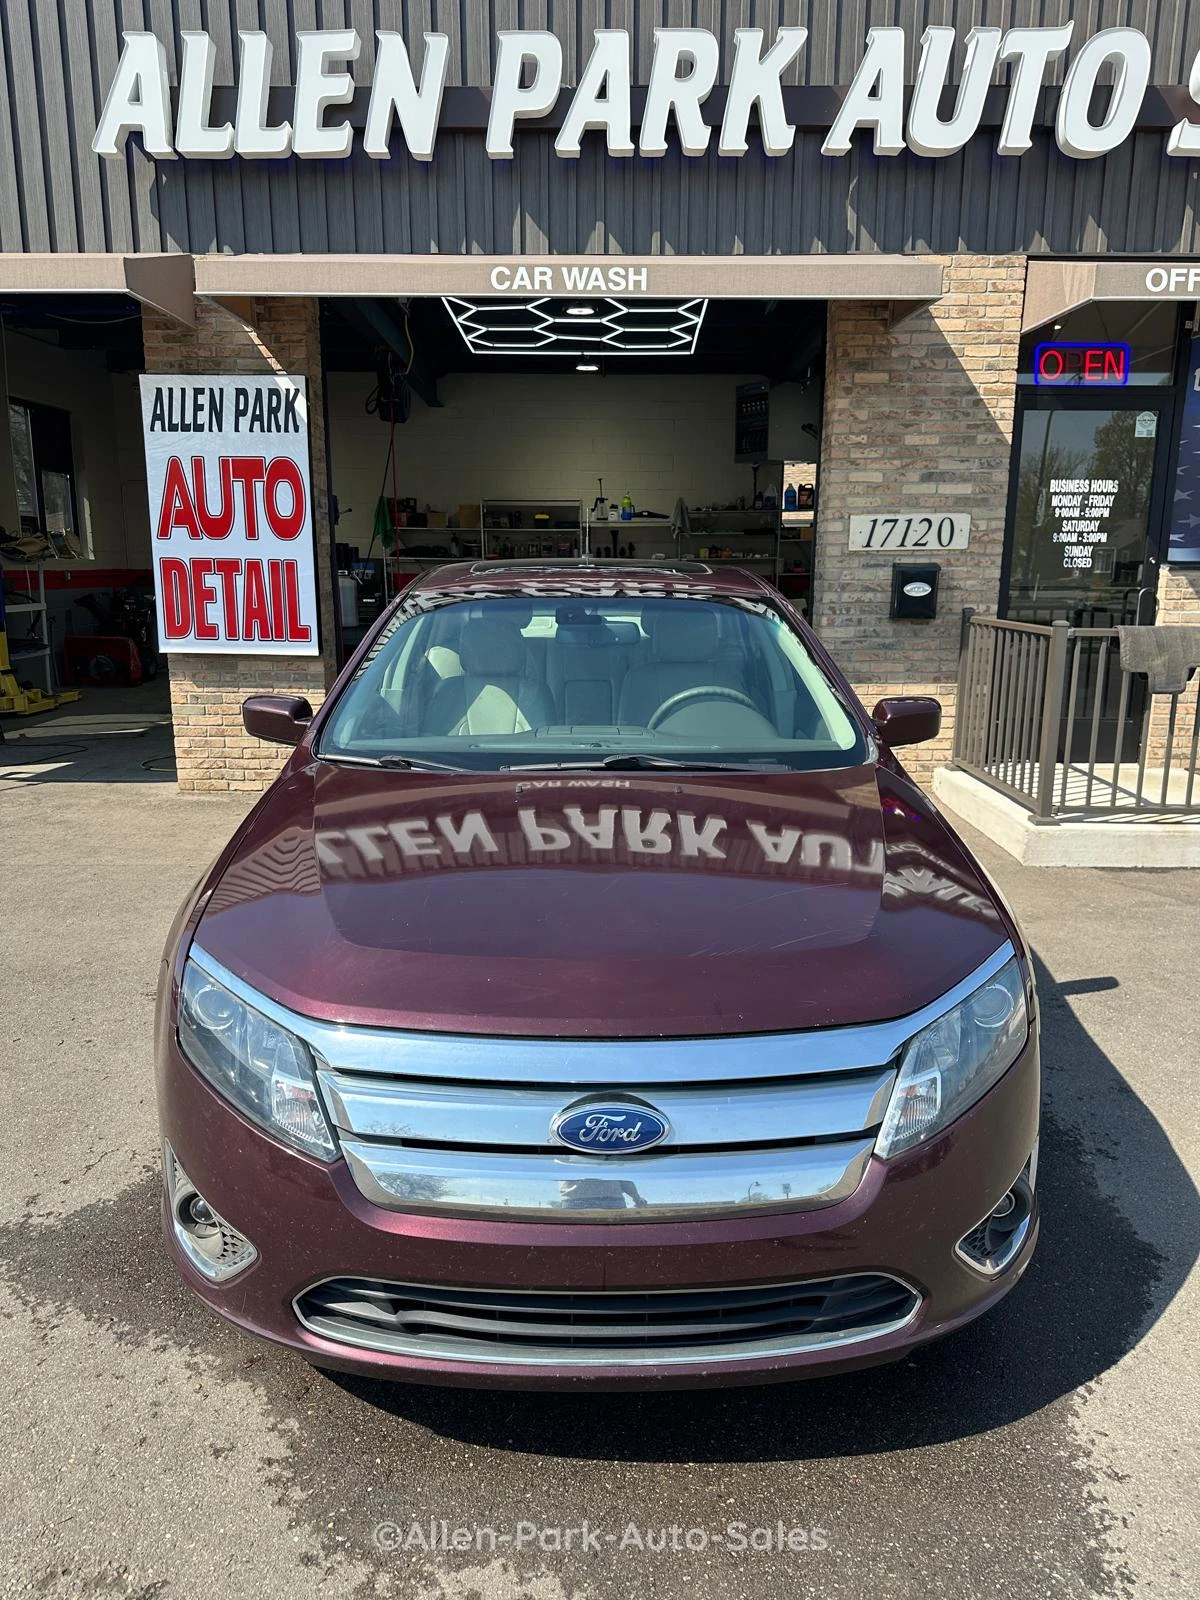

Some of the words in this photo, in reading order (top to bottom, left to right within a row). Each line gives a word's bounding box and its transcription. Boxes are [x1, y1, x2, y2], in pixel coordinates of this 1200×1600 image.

[92, 29, 450, 161] ALLEN
[486, 27, 808, 159] PARK
[821, 20, 1152, 160] AUTO
[490, 266, 553, 291] CAR
[561, 266, 648, 291] WASH
[1039, 350, 1125, 381] OPEN
[149, 386, 225, 433] ALLEN
[234, 386, 300, 434] PARK
[157, 455, 307, 541] AUTO
[1049, 479, 1090, 493] BUSINESS
[1090, 479, 1119, 493] HOURS
[1051, 494, 1082, 507] MONDAY
[1088, 494, 1115, 507] FRIDAY
[1054, 507, 1080, 518] 9:00AM
[1084, 507, 1110, 518] 5:00PM
[861, 516, 956, 548] 17120
[1052, 532, 1078, 543] 9:00AM
[1082, 532, 1108, 543] 3:00PM
[1062, 520, 1100, 532] SATURDAY
[1063, 545, 1094, 557] SUNDAY
[1063, 558, 1093, 568] CLOSED
[159, 557, 312, 642] DETAIL
[578, 1113, 643, 1143] Ford
